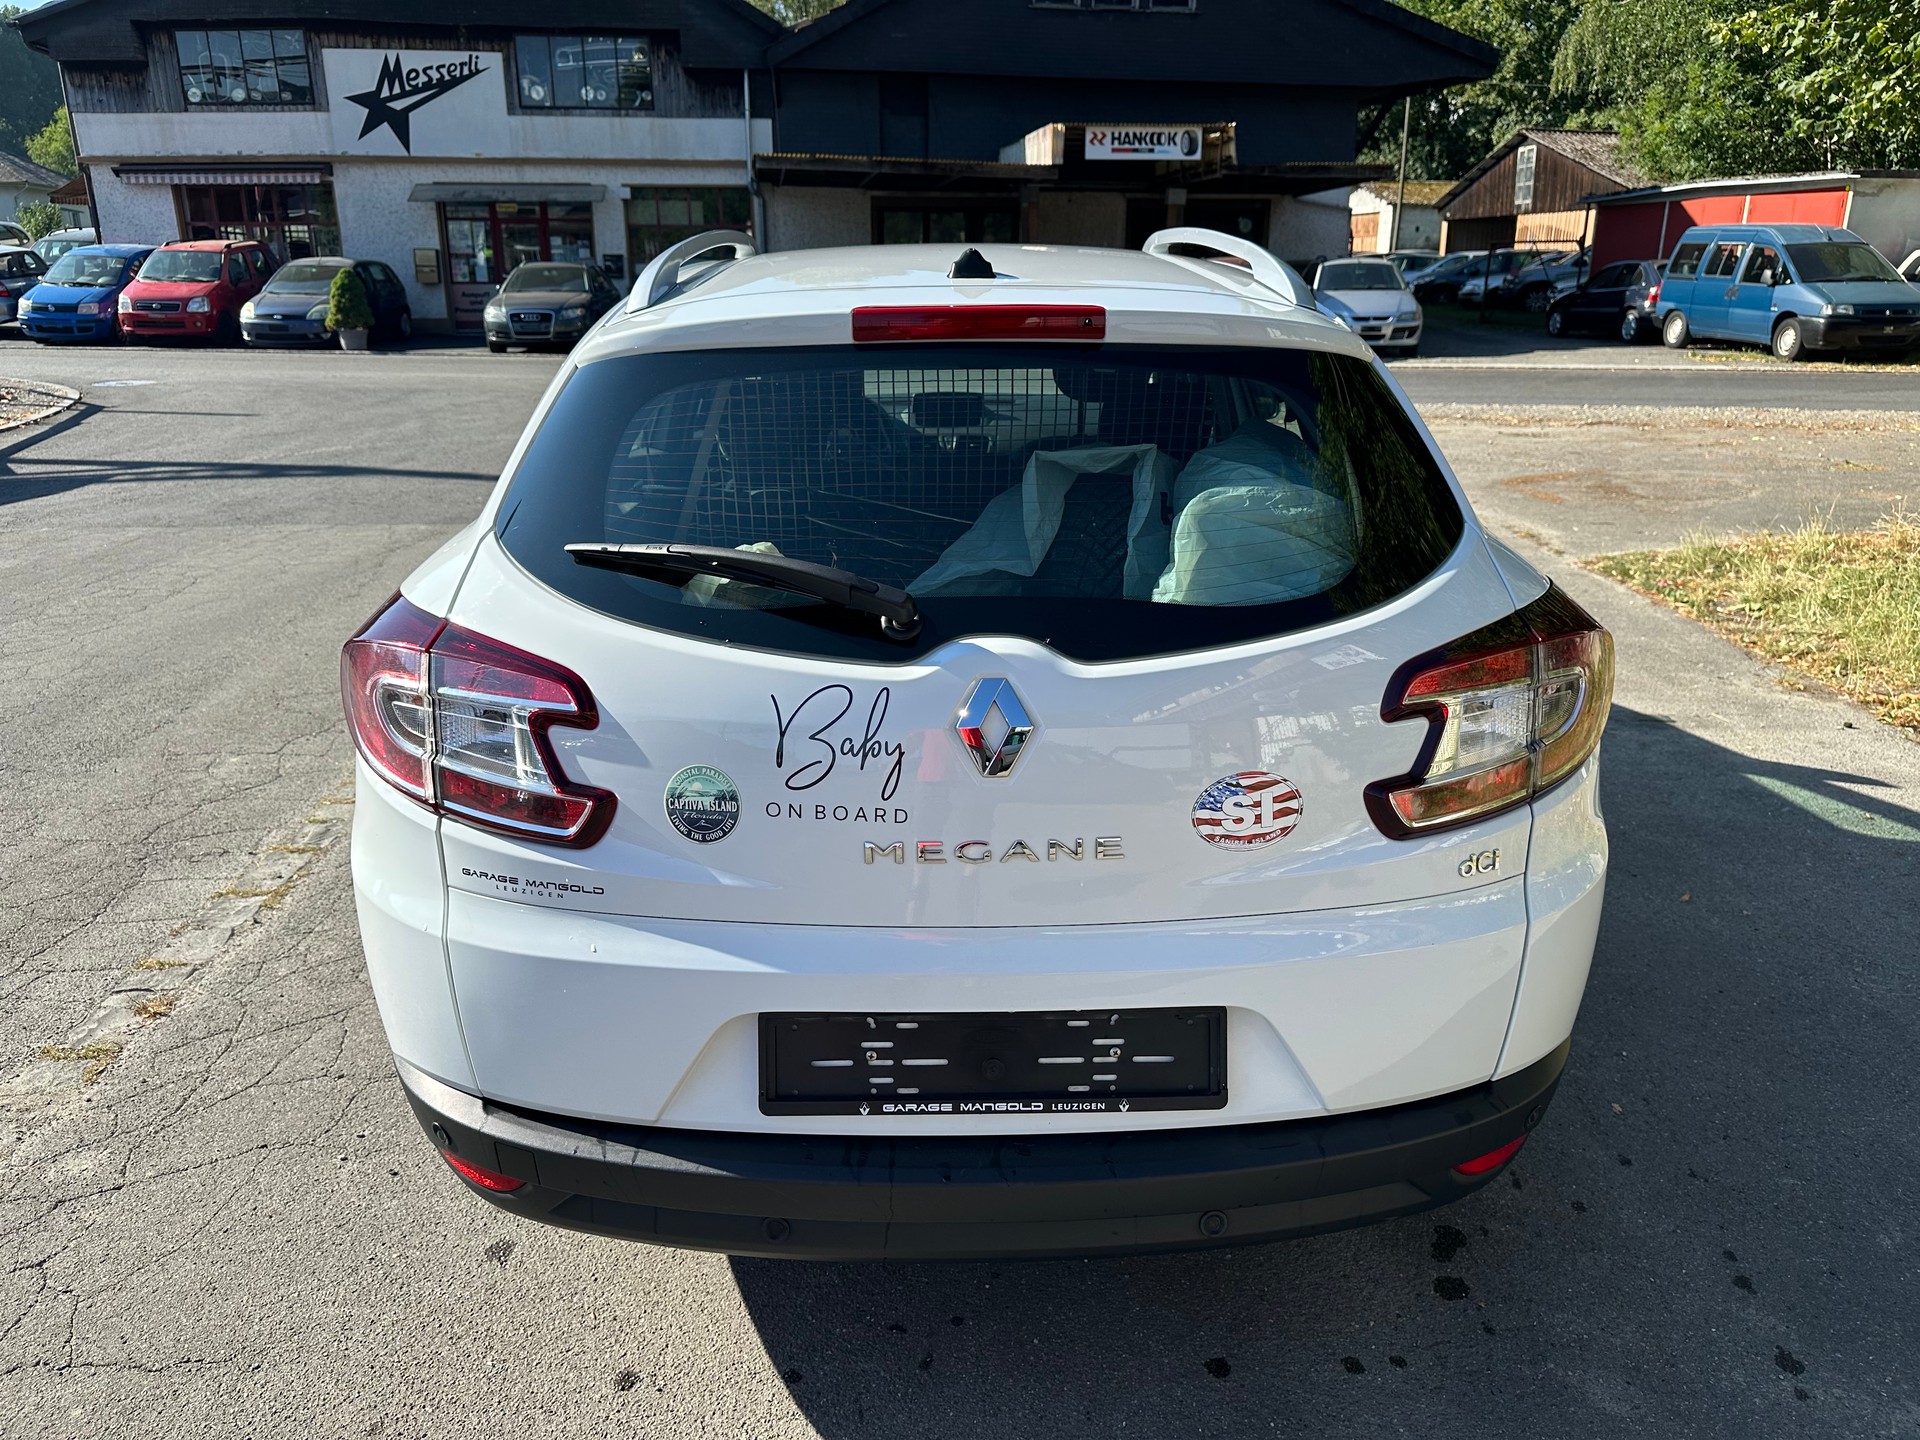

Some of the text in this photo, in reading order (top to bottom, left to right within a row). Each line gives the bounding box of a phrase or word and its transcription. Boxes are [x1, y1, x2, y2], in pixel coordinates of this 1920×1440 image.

[375, 52, 481, 99] Messerli
[1111, 132, 1177, 146] HANKOOK
[771, 684, 905, 801] Baby
[674, 768, 700, 785] COASTAL
[668, 797, 738, 812] CAPTIVA ISLAND
[766, 802, 908, 823] ON BOARD
[1221, 791, 1274, 832] SI
[683, 811, 724, 820] Florida
[670, 814, 735, 841] LIVING THE GOOD LIFE
[1213, 829, 1282, 846] SANIBEL ISLAND
[864, 837, 1126, 865] MEGANE
[1458, 848, 1500, 878] dCi
[462, 867, 605, 895] GARAGE MANGOLD
[495, 884, 564, 899] LEUZIGEN
[882, 1102, 1106, 1112] GARAGE MANGOLD LEUZIGEN
